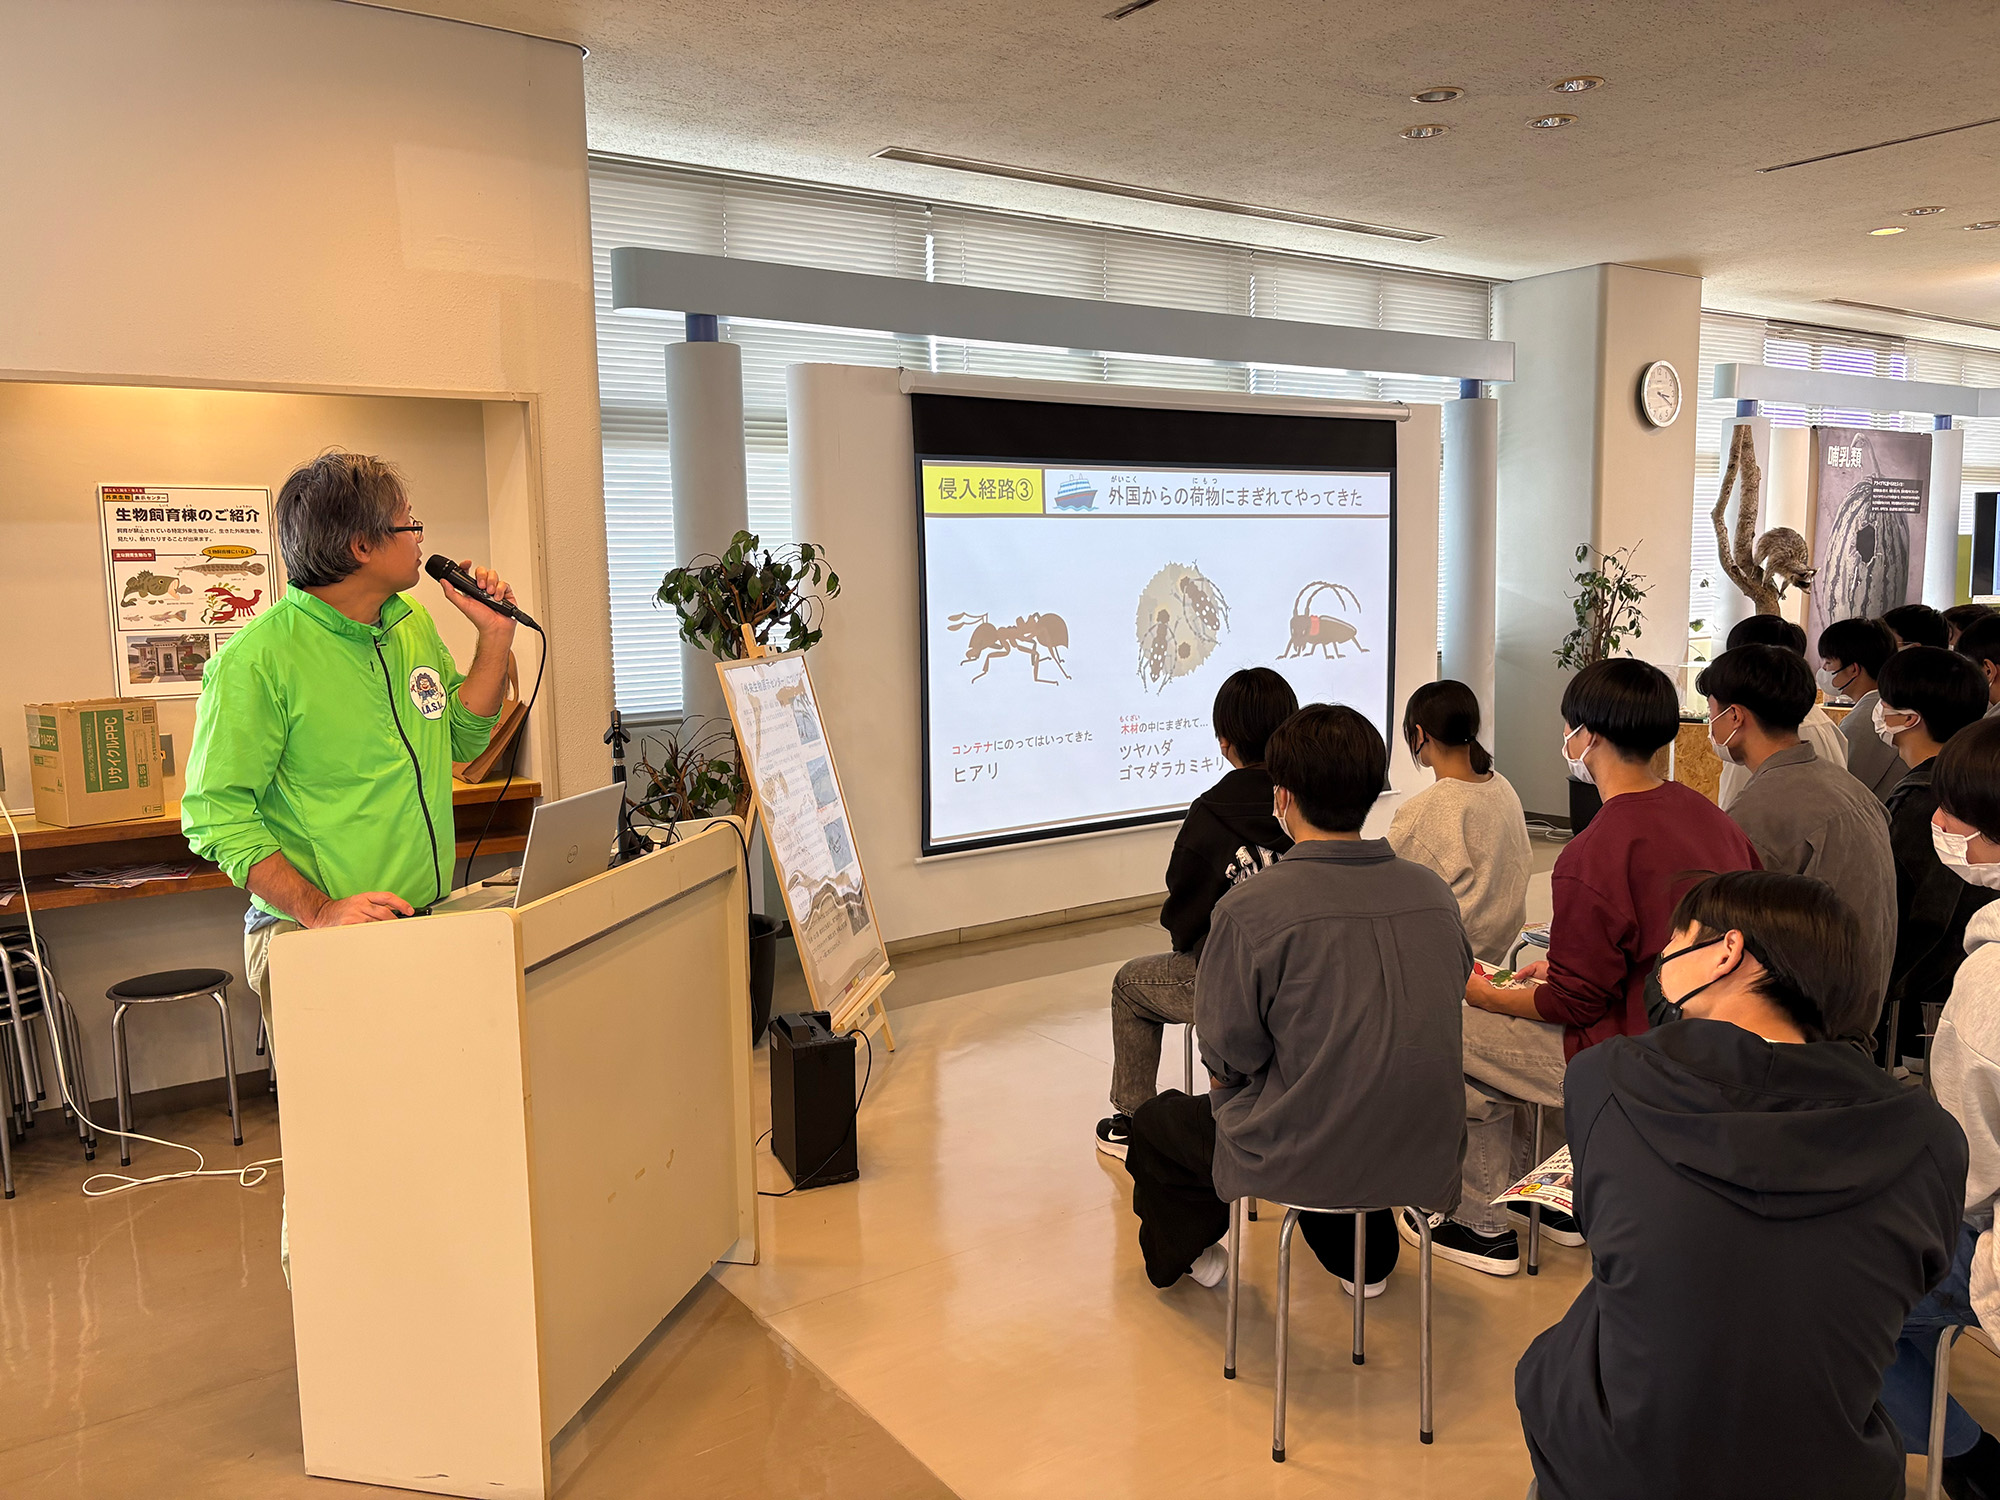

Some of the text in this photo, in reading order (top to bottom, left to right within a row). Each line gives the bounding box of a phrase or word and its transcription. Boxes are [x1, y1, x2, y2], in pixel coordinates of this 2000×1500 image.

[1827, 445, 1863, 468] 哺乳類
[938, 477, 1034, 502] 侵入経路③
[1110, 475, 1138, 484] がいこく
[1192, 477, 1218, 485] にもつ
[1108, 485, 1363, 507] 外国からの荷物にまぎれてやってきた
[115, 507, 260, 523] 生物飼育棟のご紹介
[125, 710, 135, 722] A4
[104, 717, 123, 785] リサイクルPPC
[952, 730, 1093, 755] コンテナにのってはいってきた
[1119, 738, 1173, 760] ツヤハダ
[954, 762, 998, 783] ヒアリ
[1119, 756, 1225, 781] ゴマダラカミキリ
